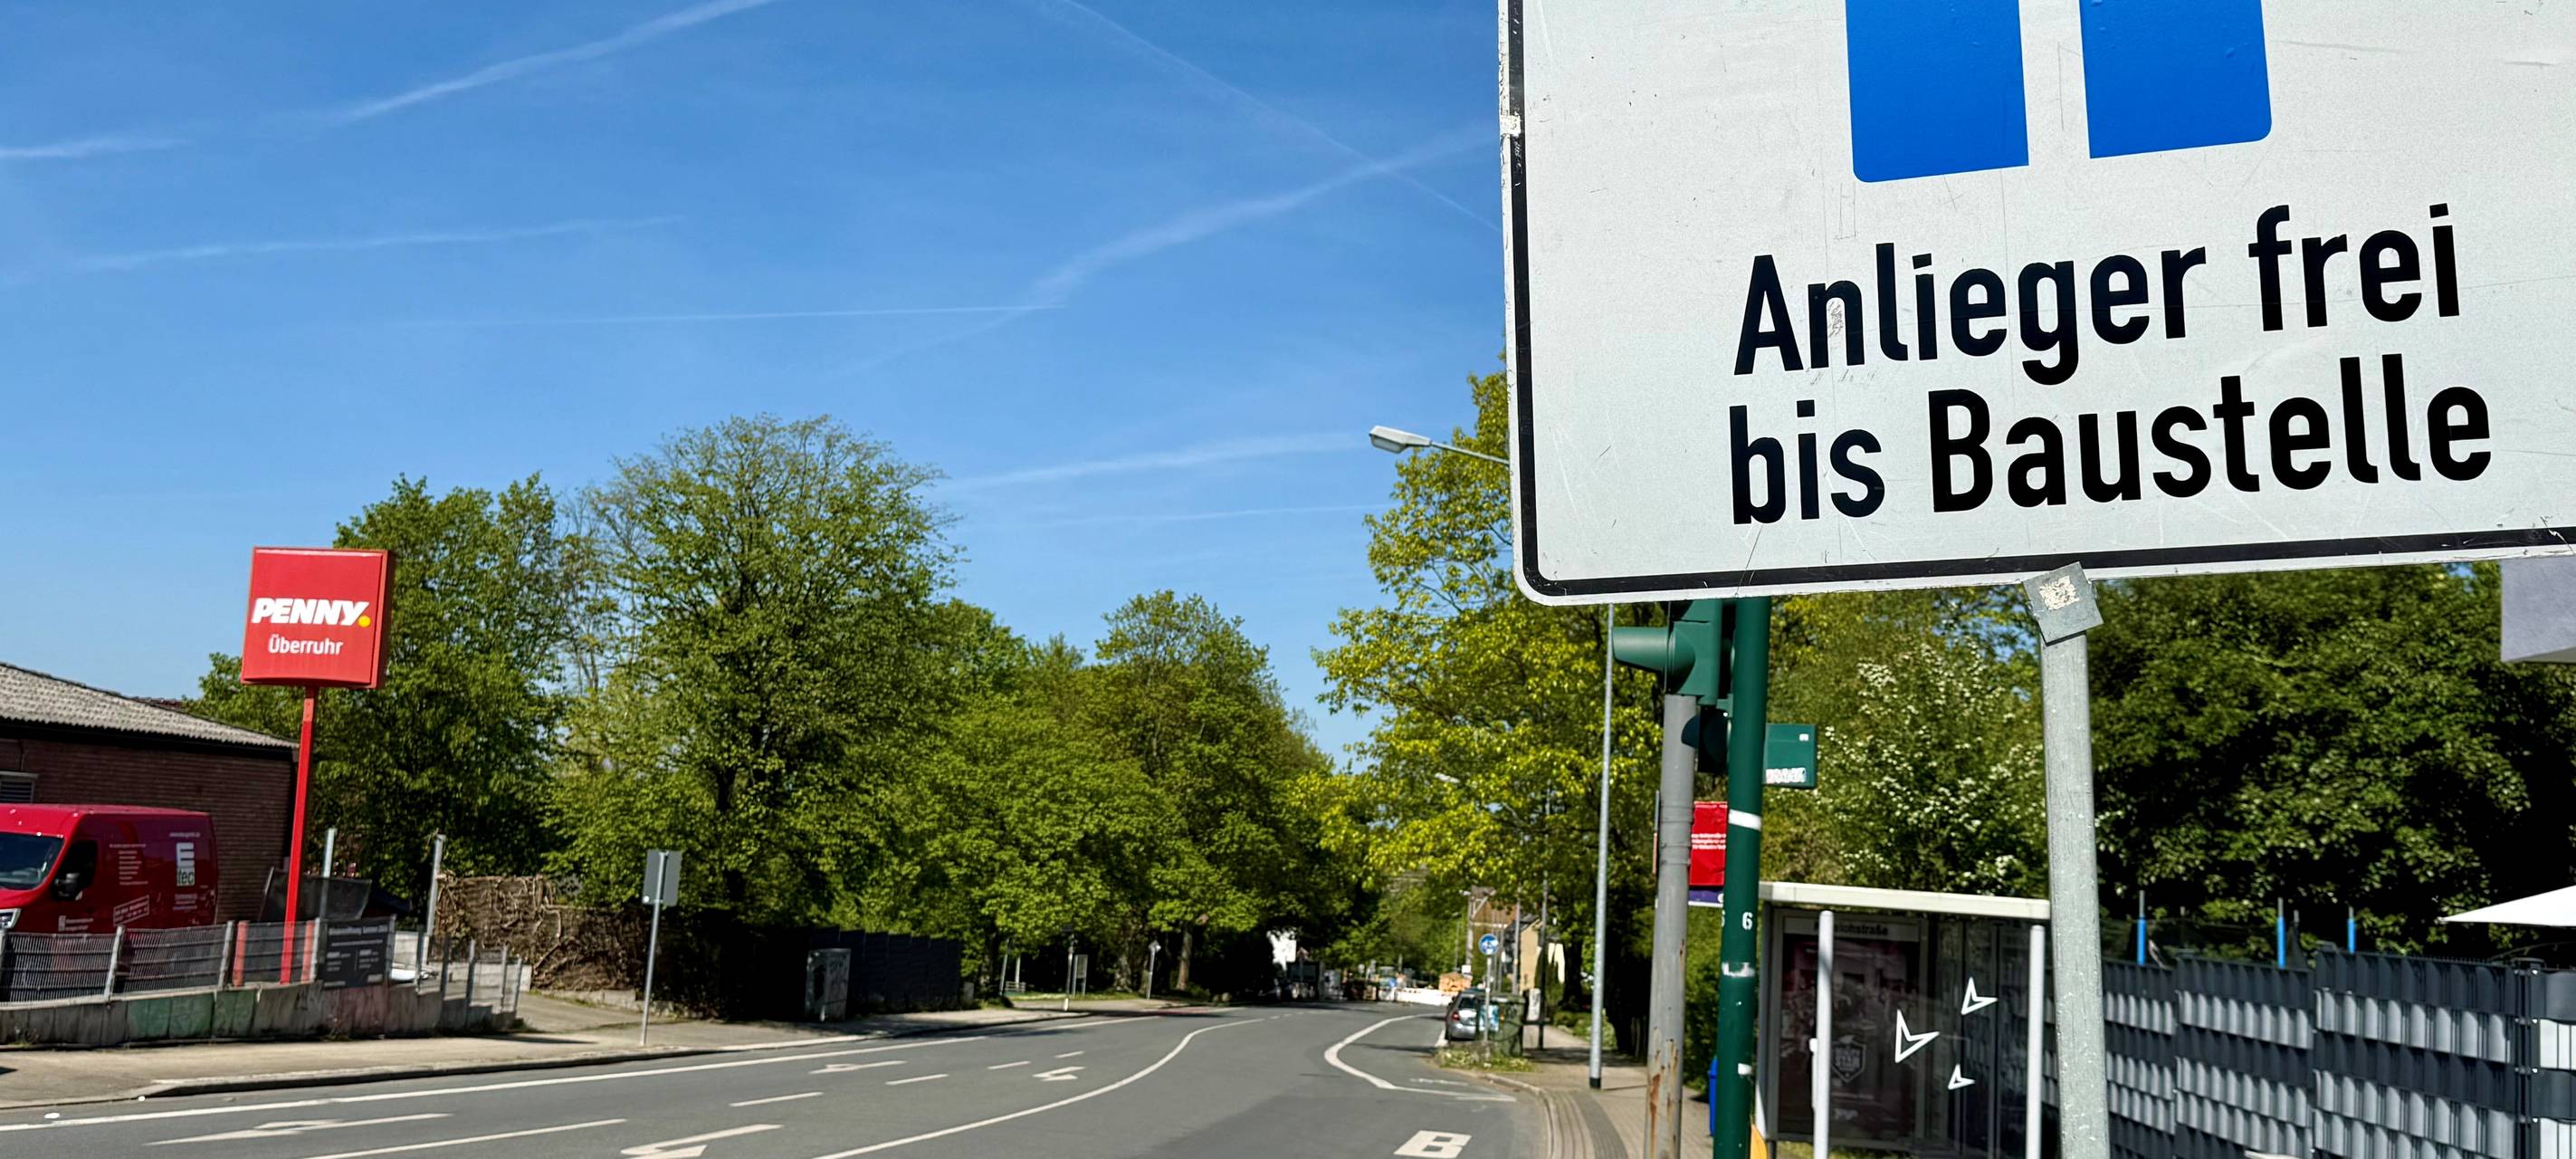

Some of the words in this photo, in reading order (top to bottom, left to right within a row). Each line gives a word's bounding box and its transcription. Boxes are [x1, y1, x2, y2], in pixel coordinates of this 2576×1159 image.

[1733, 243, 2207, 386] Anlieger
[2248, 203, 2459, 331] frei
[1730, 399, 1885, 524] bis
[1929, 354, 2492, 513] Baustelle
[268, 634, 344, 656] Überruhr
[1742, 911, 1753, 931] 6
